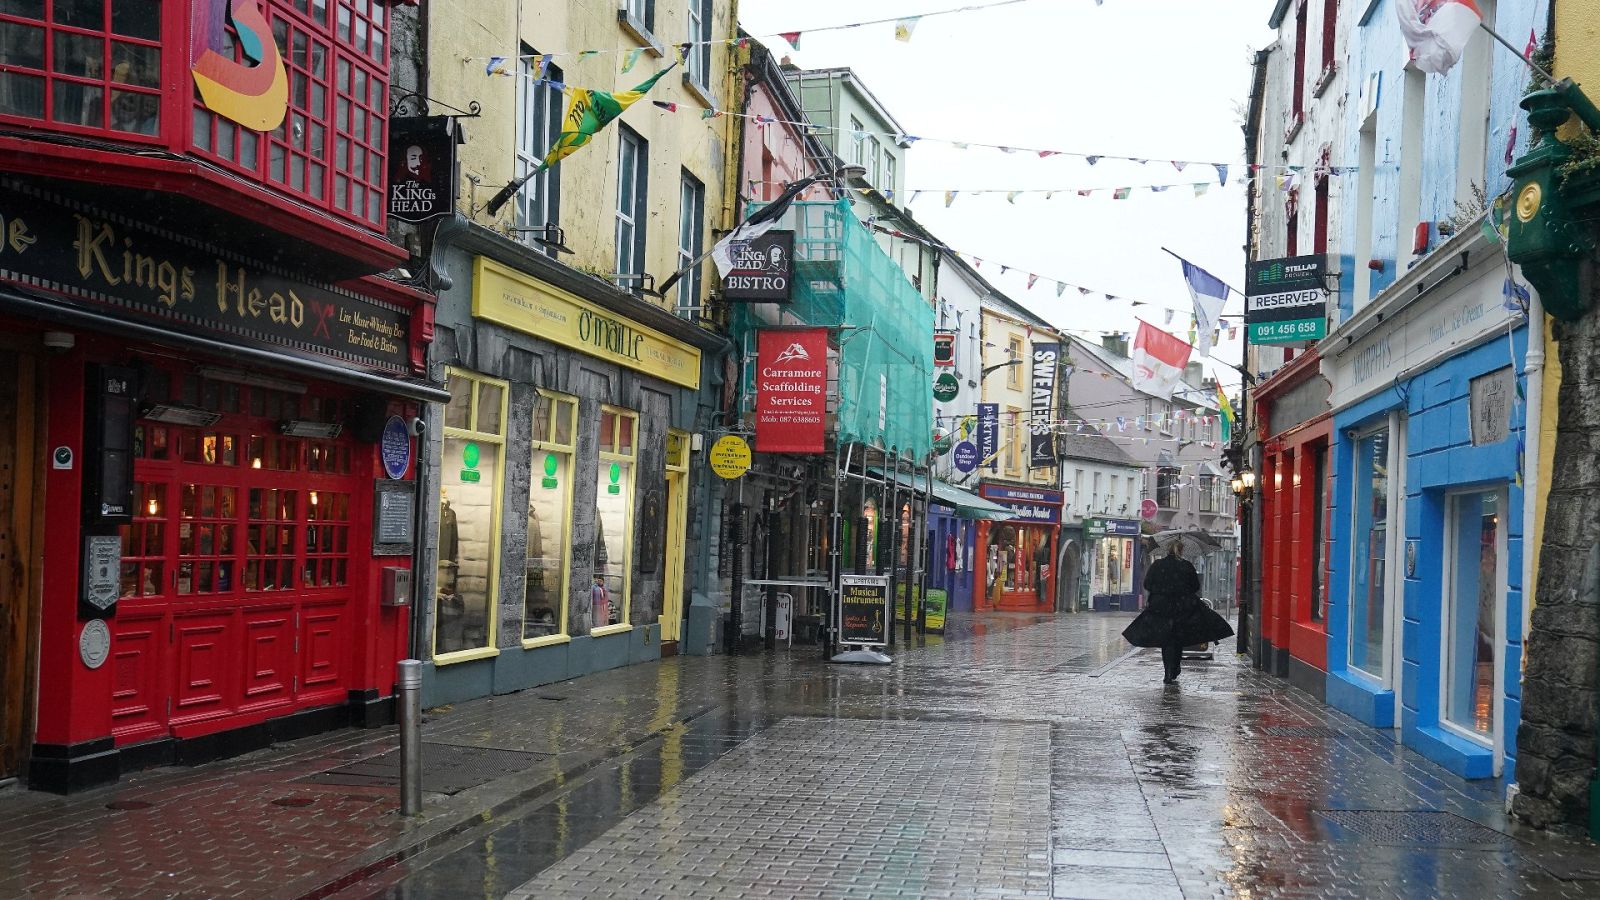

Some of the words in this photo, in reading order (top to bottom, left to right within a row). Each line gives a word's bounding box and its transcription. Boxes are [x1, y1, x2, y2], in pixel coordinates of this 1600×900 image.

[405, 180, 419, 188] The
[392, 200, 432, 212] HEAD
[73, 213, 196, 309] Kings
[216, 258, 304, 328] Head
[727, 276, 786, 290] BISTRO
[1256, 291, 1318, 307] RESERVED
[340, 307, 352, 325] Live
[1257, 326, 1275, 336] 091
[1277, 323, 1296, 334] 456
[1297, 321, 1316, 332] 658
[348, 328, 360, 346] Bar
[360, 332, 374, 348] Food
[380, 336, 398, 354] Bistro
[763, 367, 822, 378] Carramore
[763, 382, 821, 394] Scaffolding
[770, 396, 812, 406] Services
[850, 587, 878, 596] Musical
[843, 595, 885, 605] Instruments
